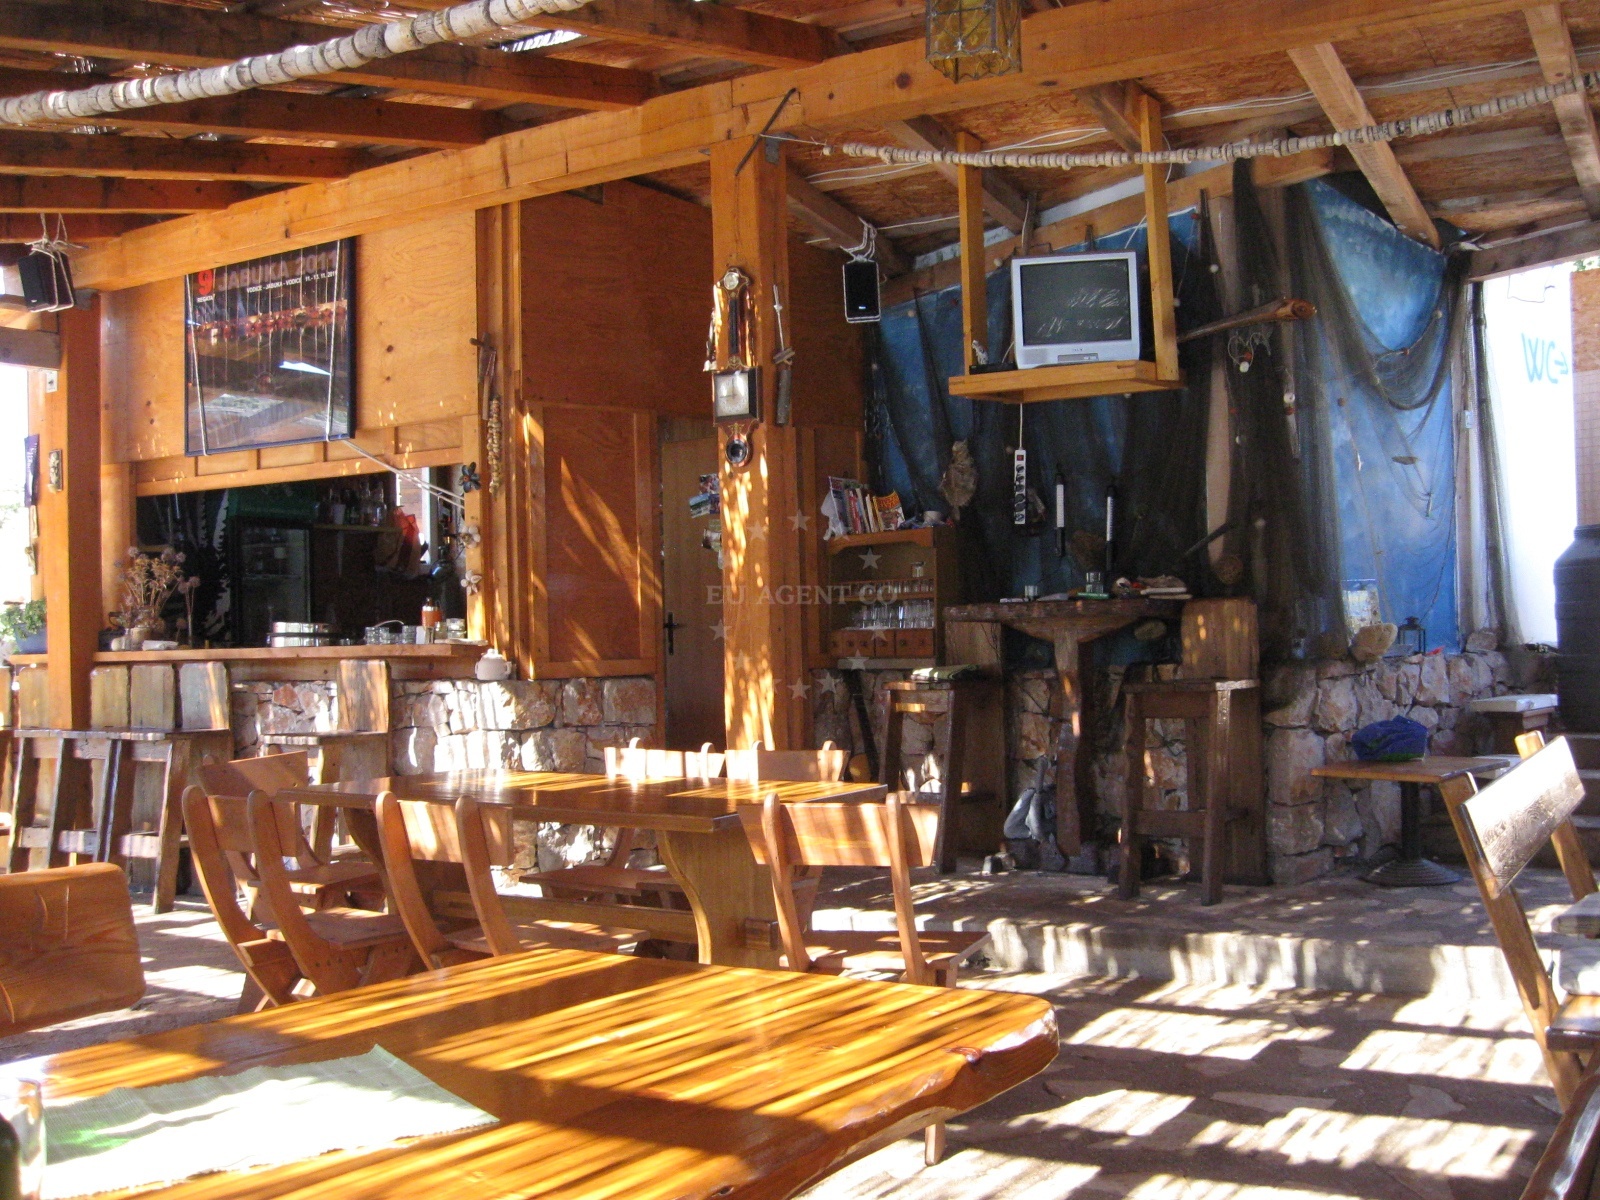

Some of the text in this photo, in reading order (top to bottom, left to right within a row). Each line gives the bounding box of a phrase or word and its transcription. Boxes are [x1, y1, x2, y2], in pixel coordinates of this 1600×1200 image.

[198, 269, 213, 295] 9
[218, 250, 337, 291] JABUKA 2011
[247, 285, 262, 293] VODICE
[1521, 333, 1558, 384] WC
